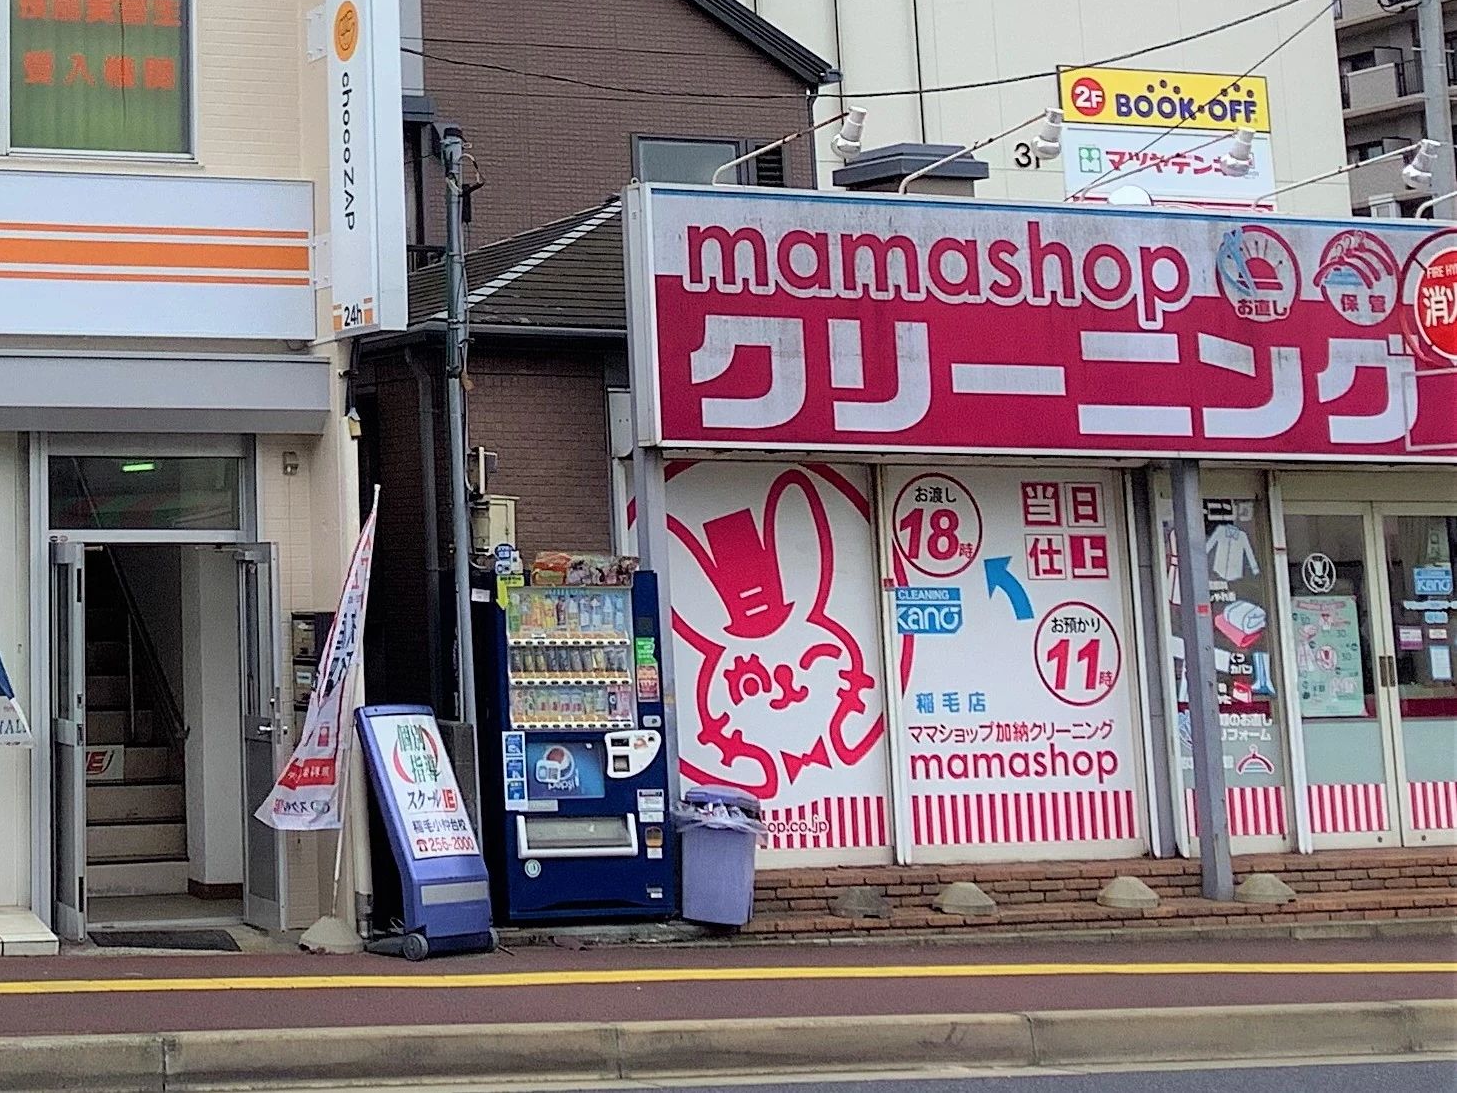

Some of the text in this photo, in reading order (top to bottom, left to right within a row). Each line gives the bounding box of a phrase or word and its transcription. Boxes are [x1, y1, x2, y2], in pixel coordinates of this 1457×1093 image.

[1075, 87, 1103, 108] 2F
[341, 71, 355, 232] chocoZAP
[686, 220, 1192, 322] mamashop
[344, 303, 363, 328] 24h
[1237, 299, 1288, 317] お直し
[690, 314, 1420, 446] クリーニング
[914, 486, 958, 504] お渡し
[1023, 483, 1100, 526] 当日
[899, 508, 974, 561] 18時
[1028, 535, 1108, 578] 仕上
[898, 589, 950, 600] CLEANING
[1050, 616, 1101, 634] お預かり
[1046, 639, 1114, 691] 11時
[915, 692, 987, 714] 稲毛店
[396, 724, 426, 752] 個別
[908, 718, 1115, 744] ママショップ加納クリーニング
[410, 754, 441, 783] 指導
[910, 743, 1118, 784] mamashop
[762, 815, 828, 834] op.co.jp
[428, 836, 474, 852] 256-2000
